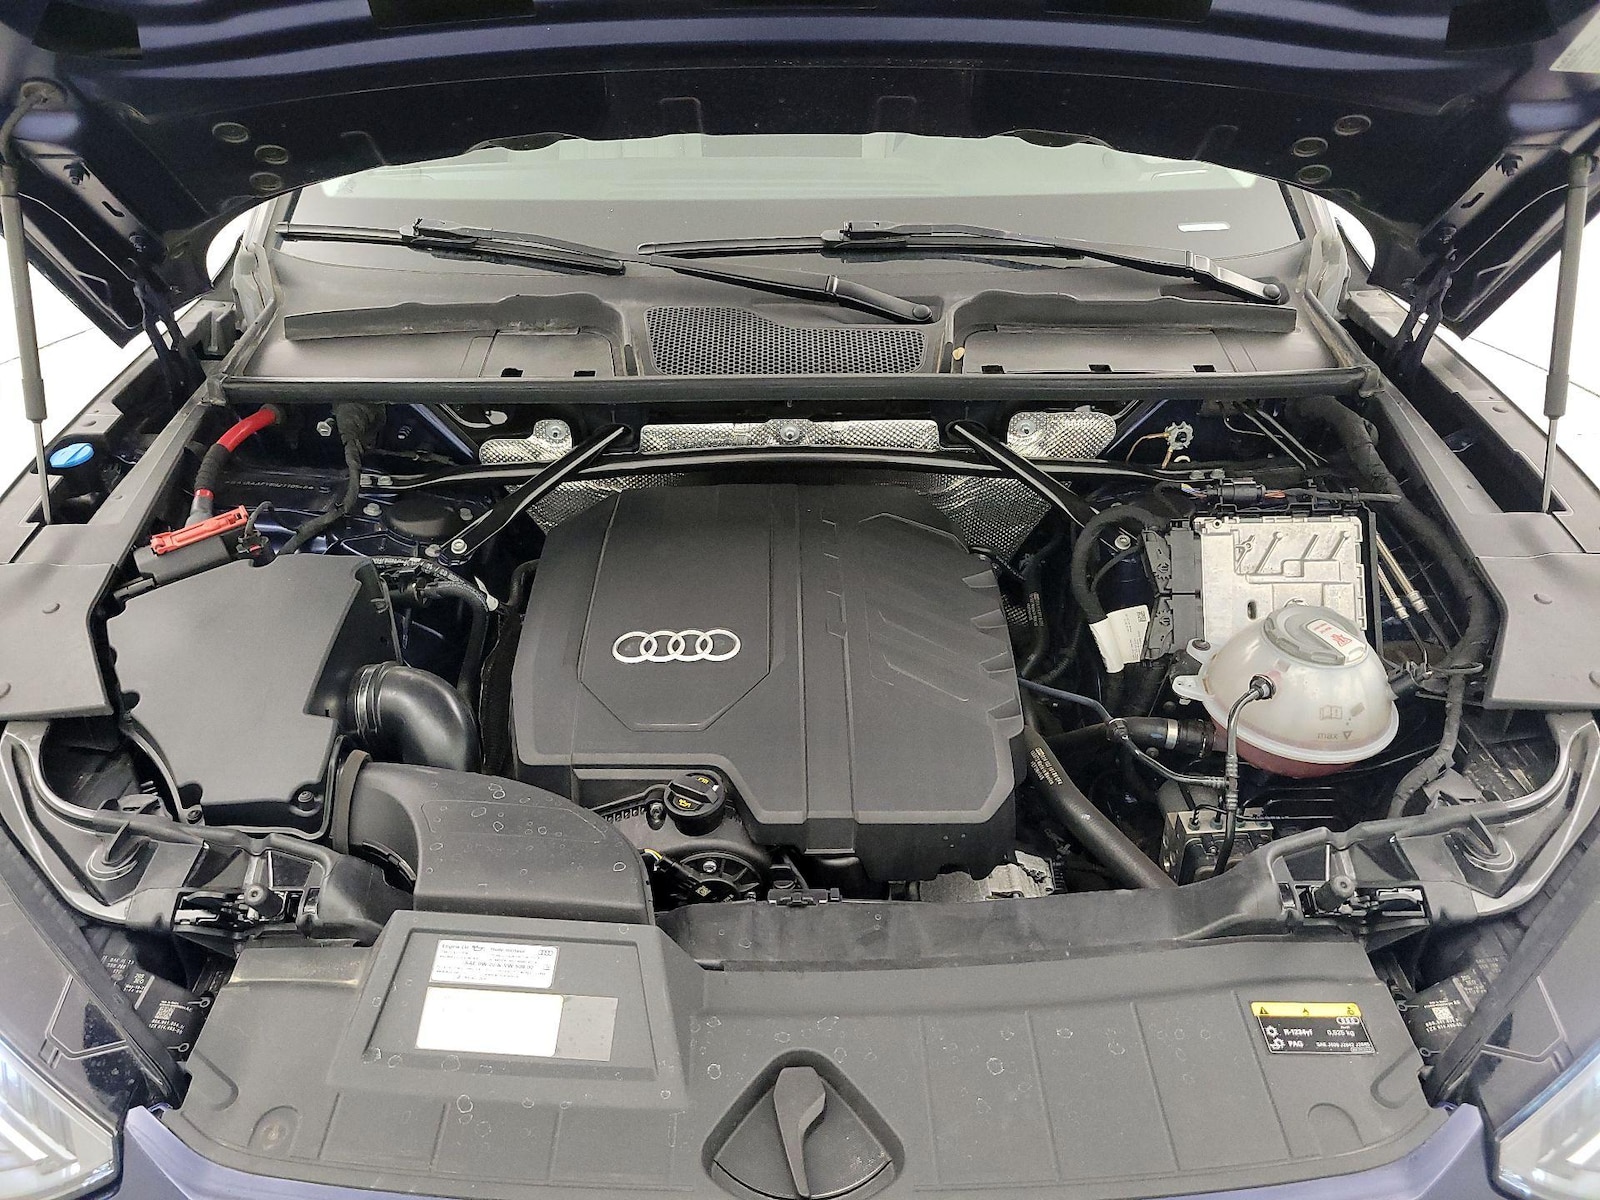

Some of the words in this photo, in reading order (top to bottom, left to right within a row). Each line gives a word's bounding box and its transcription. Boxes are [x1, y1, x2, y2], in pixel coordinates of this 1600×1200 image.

[1317, 732, 1338, 740] max
[1283, 1028, 1313, 1036] R-1234yf
[1346, 1029, 1355, 1037] kg
[1287, 1040, 1304, 1048] PAG
